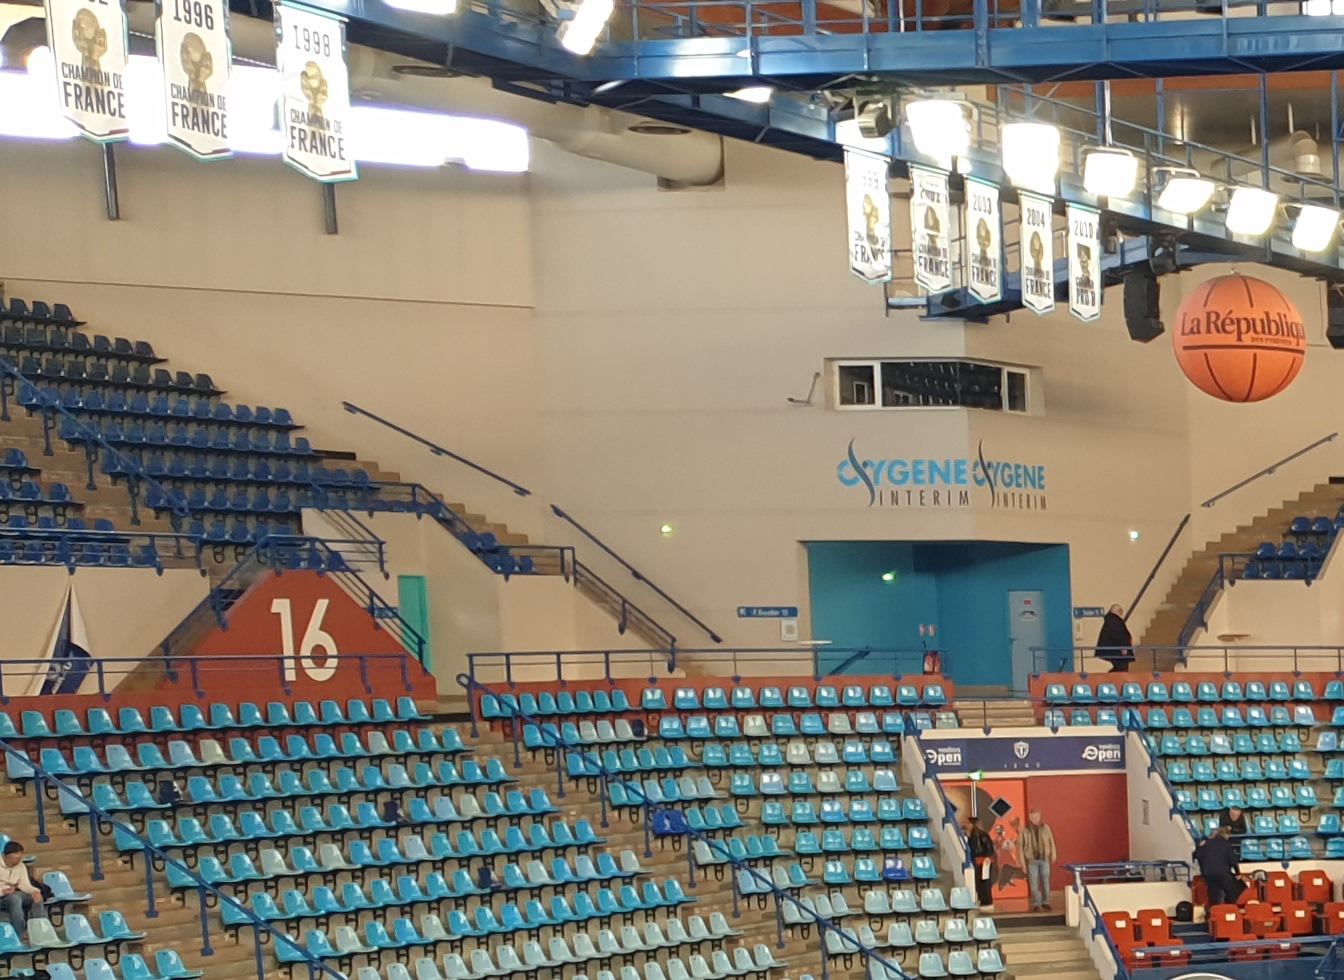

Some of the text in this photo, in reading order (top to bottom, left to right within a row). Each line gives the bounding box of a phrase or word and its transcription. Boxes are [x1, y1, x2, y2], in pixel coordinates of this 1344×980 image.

[173, 0, 214, 30] 1996
[293, 25, 331, 57] 1998
[63, 80, 126, 119] FRANCE
[171, 100, 228, 139] FRANCE
[289, 125, 346, 161] FRANCE
[1026, 207, 1046, 227] 2004
[1074, 219, 1094, 239] 2010
[1025, 277, 1052, 300] FRANCE
[1180, 311, 1202, 336] La
[879, 489, 970, 507] INTERIM
[997, 492, 1047, 511] INTERIM
[270, 598, 339, 682] 16
